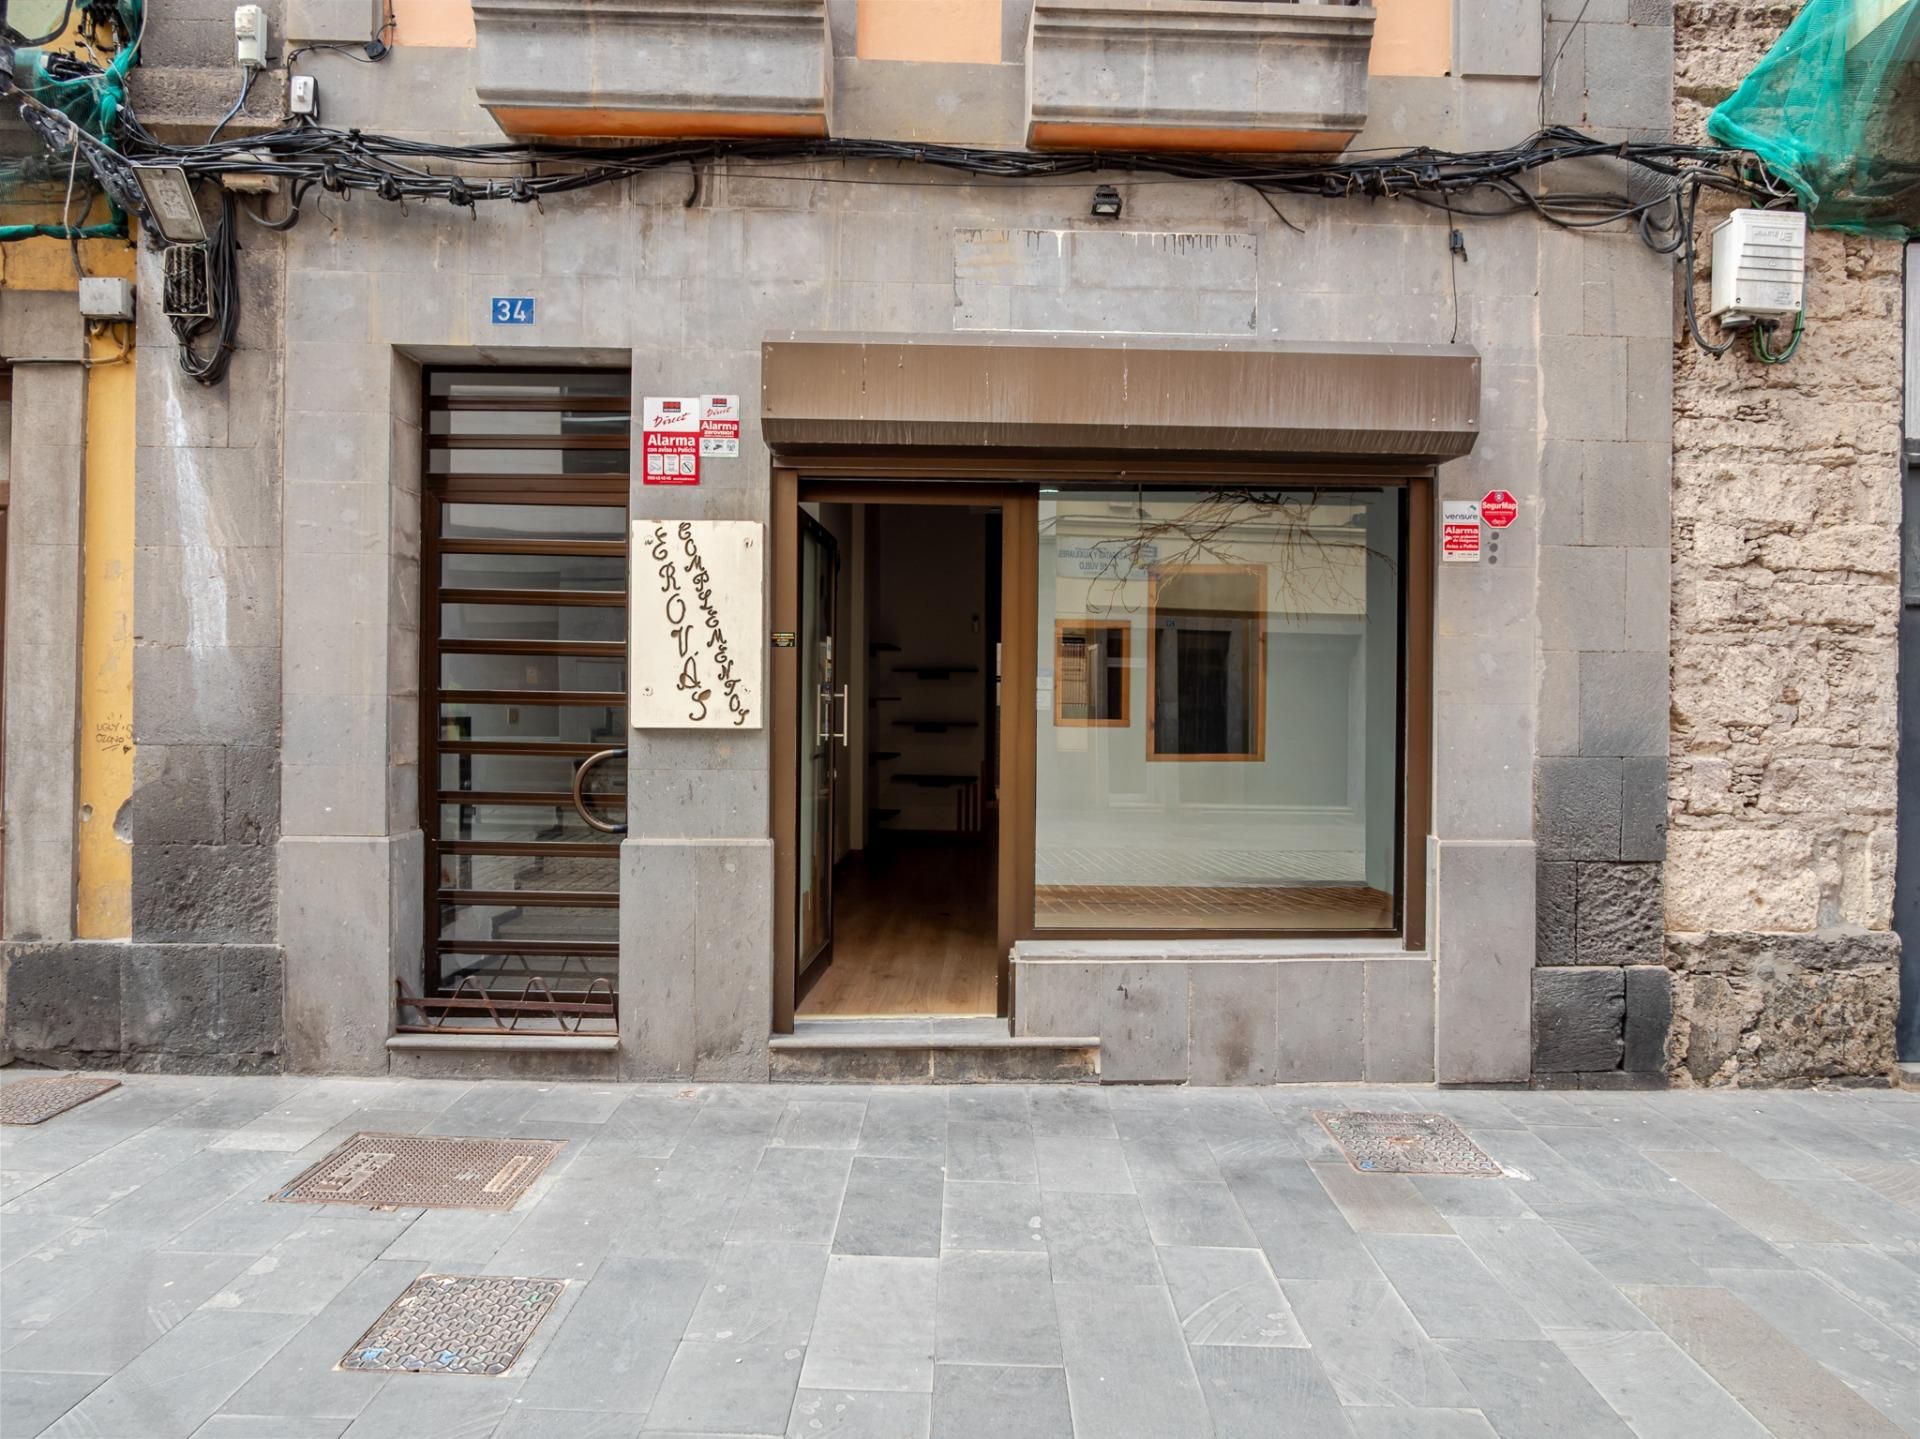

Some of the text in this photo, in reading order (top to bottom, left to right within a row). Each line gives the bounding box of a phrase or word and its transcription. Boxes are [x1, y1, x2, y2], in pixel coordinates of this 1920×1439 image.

[497, 300, 526, 321] 34
[653, 412, 691, 428] Direct
[701, 420, 738, 431] Alarma
[647, 434, 695, 446] Alarma
[1445, 526, 1479, 534] Alarma
